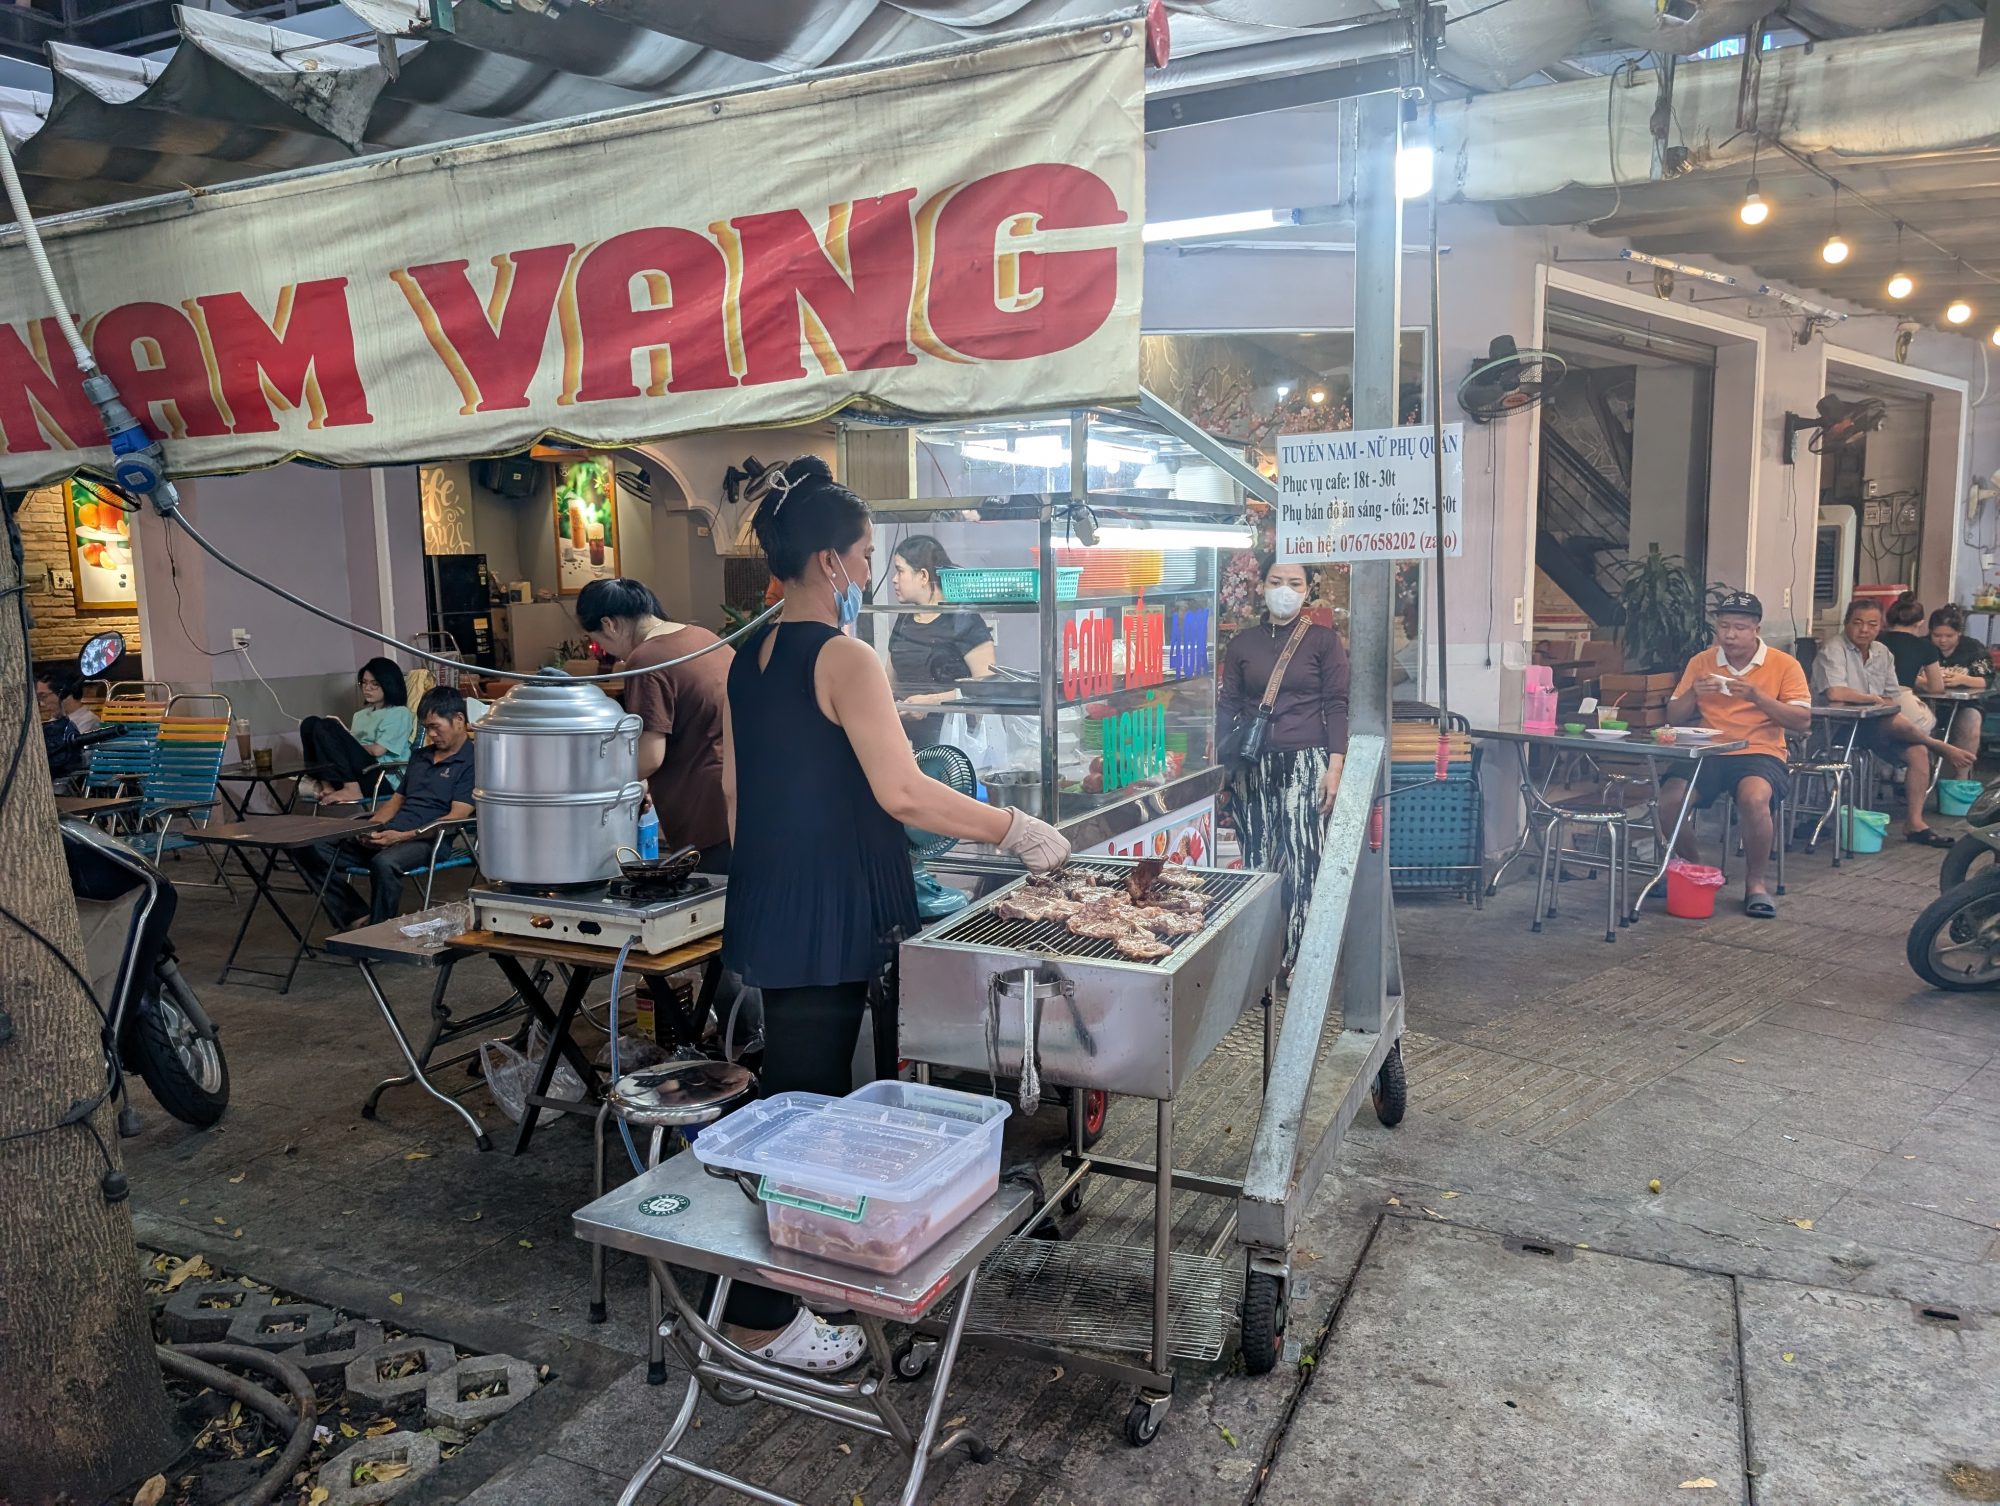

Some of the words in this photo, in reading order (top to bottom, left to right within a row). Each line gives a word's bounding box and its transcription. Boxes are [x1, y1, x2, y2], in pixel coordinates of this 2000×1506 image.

[0, 277, 374, 453] NAM
[390, 163, 1128, 414] VANG
[1327, 441, 1357, 462] NAM
[1367, 435, 1388, 459] NỮ
[1390, 437, 1416, 461] PHỤ
[1419, 430, 1458, 459] QUÁN
[420, 468, 455, 522] ife
[1282, 475, 1307, 497] Phục
[1310, 478, 1323, 496] vụ
[1325, 472, 1350, 490] cafe:
[1353, 470, 1370, 489] 18t
[1379, 468, 1396, 488] 30t
[1282, 504, 1302, 526] Phụ
[1305, 502, 1324, 520] bán
[1326, 496, 1340, 520] đồ
[1342, 502, 1355, 518] ăn
[1357, 499, 1382, 522] sáng
[1391, 493, 1409, 516] tối:
[1412, 496, 1429, 515] 25t
[1285, 536, 1313, 555] Liên
[1317, 535, 1336, 558] hệ:
[1340, 531, 1416, 553] 0767658202
[1420, 529, 1457, 553] (zao)
[1063, 611, 1114, 702] CƠM
[1124, 586, 1164, 690] TẤM
[1169, 608, 1210, 681] 40K
[1797, 1291, 1889, 1316] SCTV
